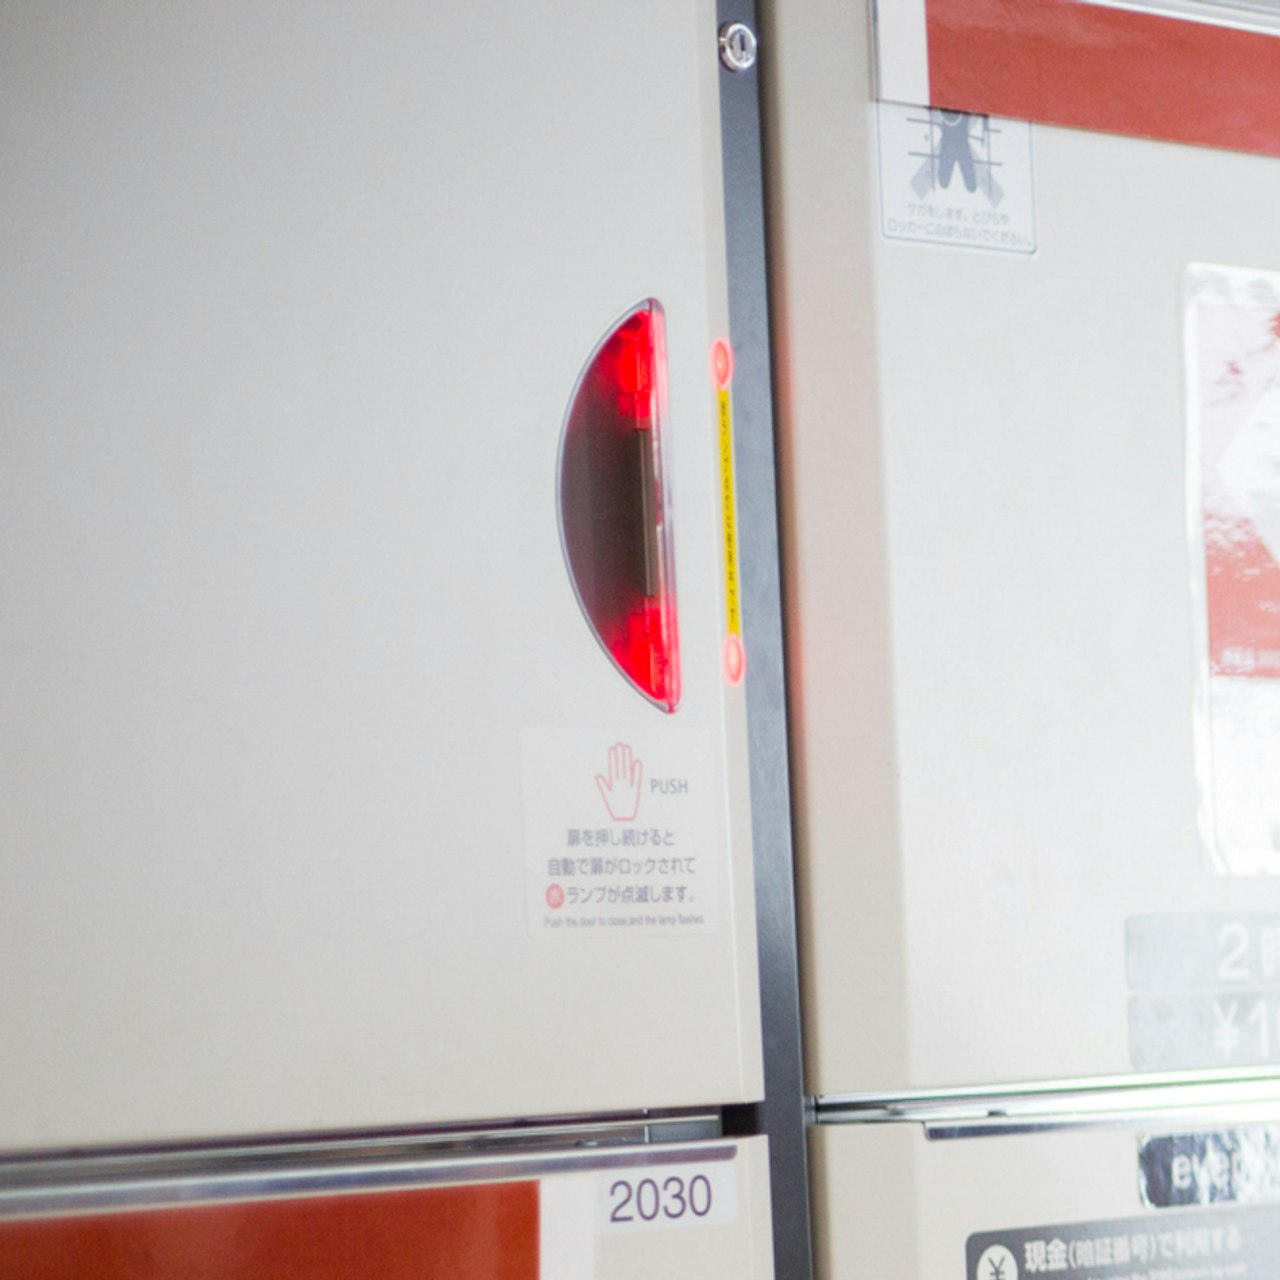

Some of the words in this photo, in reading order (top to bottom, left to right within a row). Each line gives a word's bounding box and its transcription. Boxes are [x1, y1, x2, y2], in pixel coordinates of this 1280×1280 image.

[650, 779, 689, 794] PUSH
[567, 829, 675, 848] 扉を押し続けると
[548, 857, 696, 876] 自動で扉がロックされて
[610, 1174, 712, 1222] 2030
